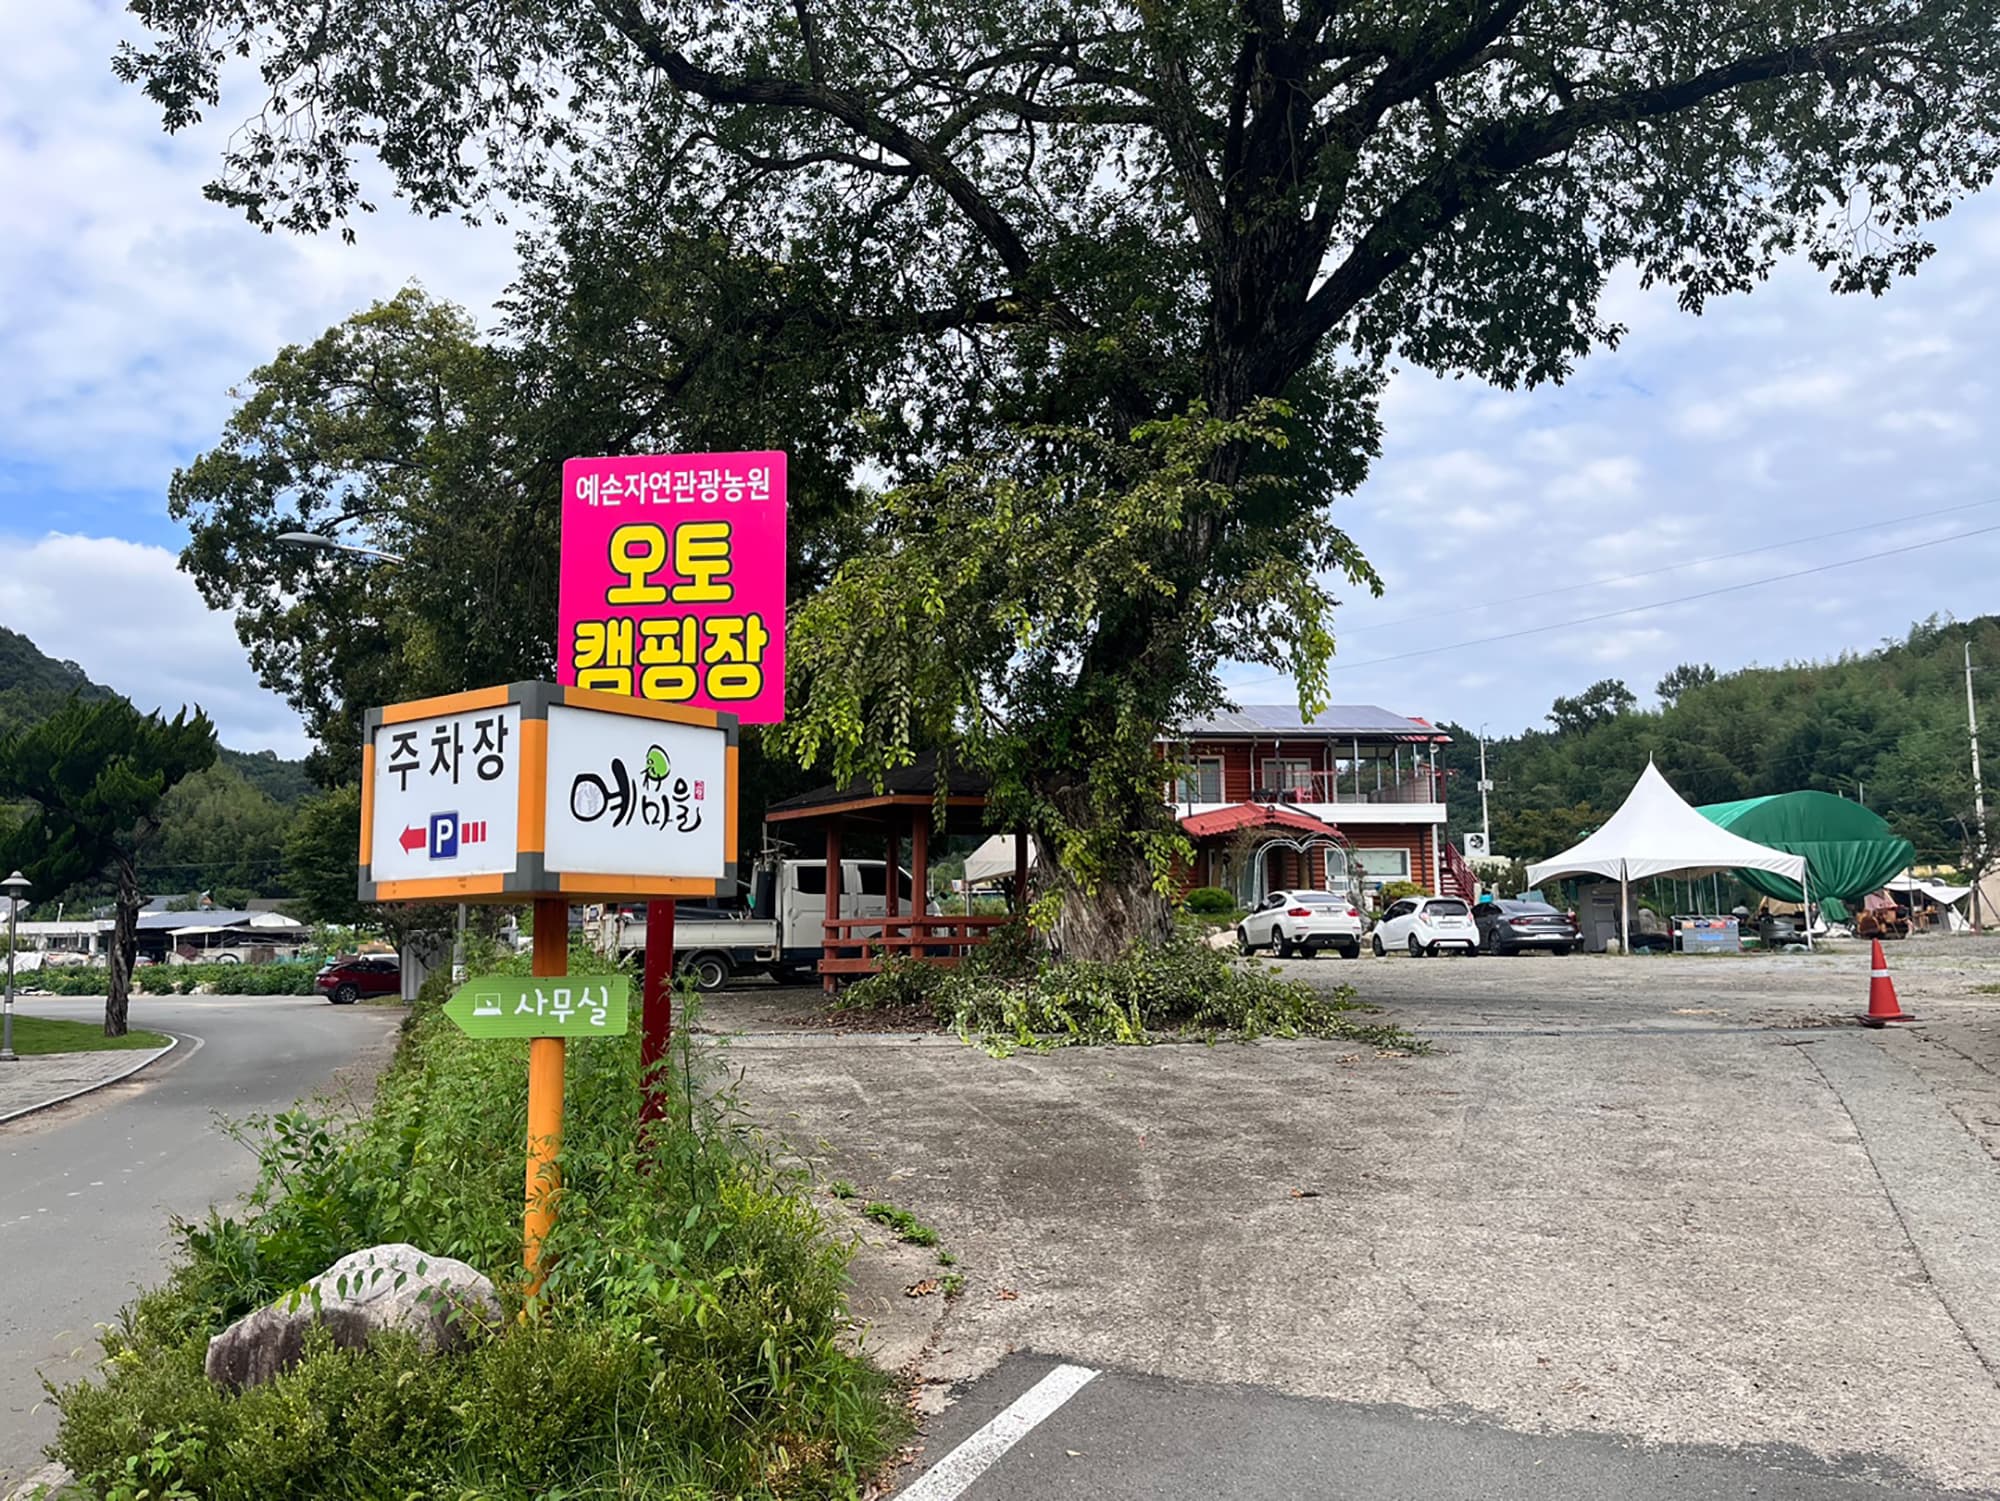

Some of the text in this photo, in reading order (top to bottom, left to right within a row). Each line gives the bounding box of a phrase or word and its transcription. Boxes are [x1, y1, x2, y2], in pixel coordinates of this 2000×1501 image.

[575, 467, 770, 506] 예손자연관광농원
[605, 520, 735, 606] 오토
[572, 612, 770, 702] 캠핑장
[388, 714, 509, 792] 주차장
[435, 818, 455, 854] P
[514, 986, 609, 1026] 사무실
